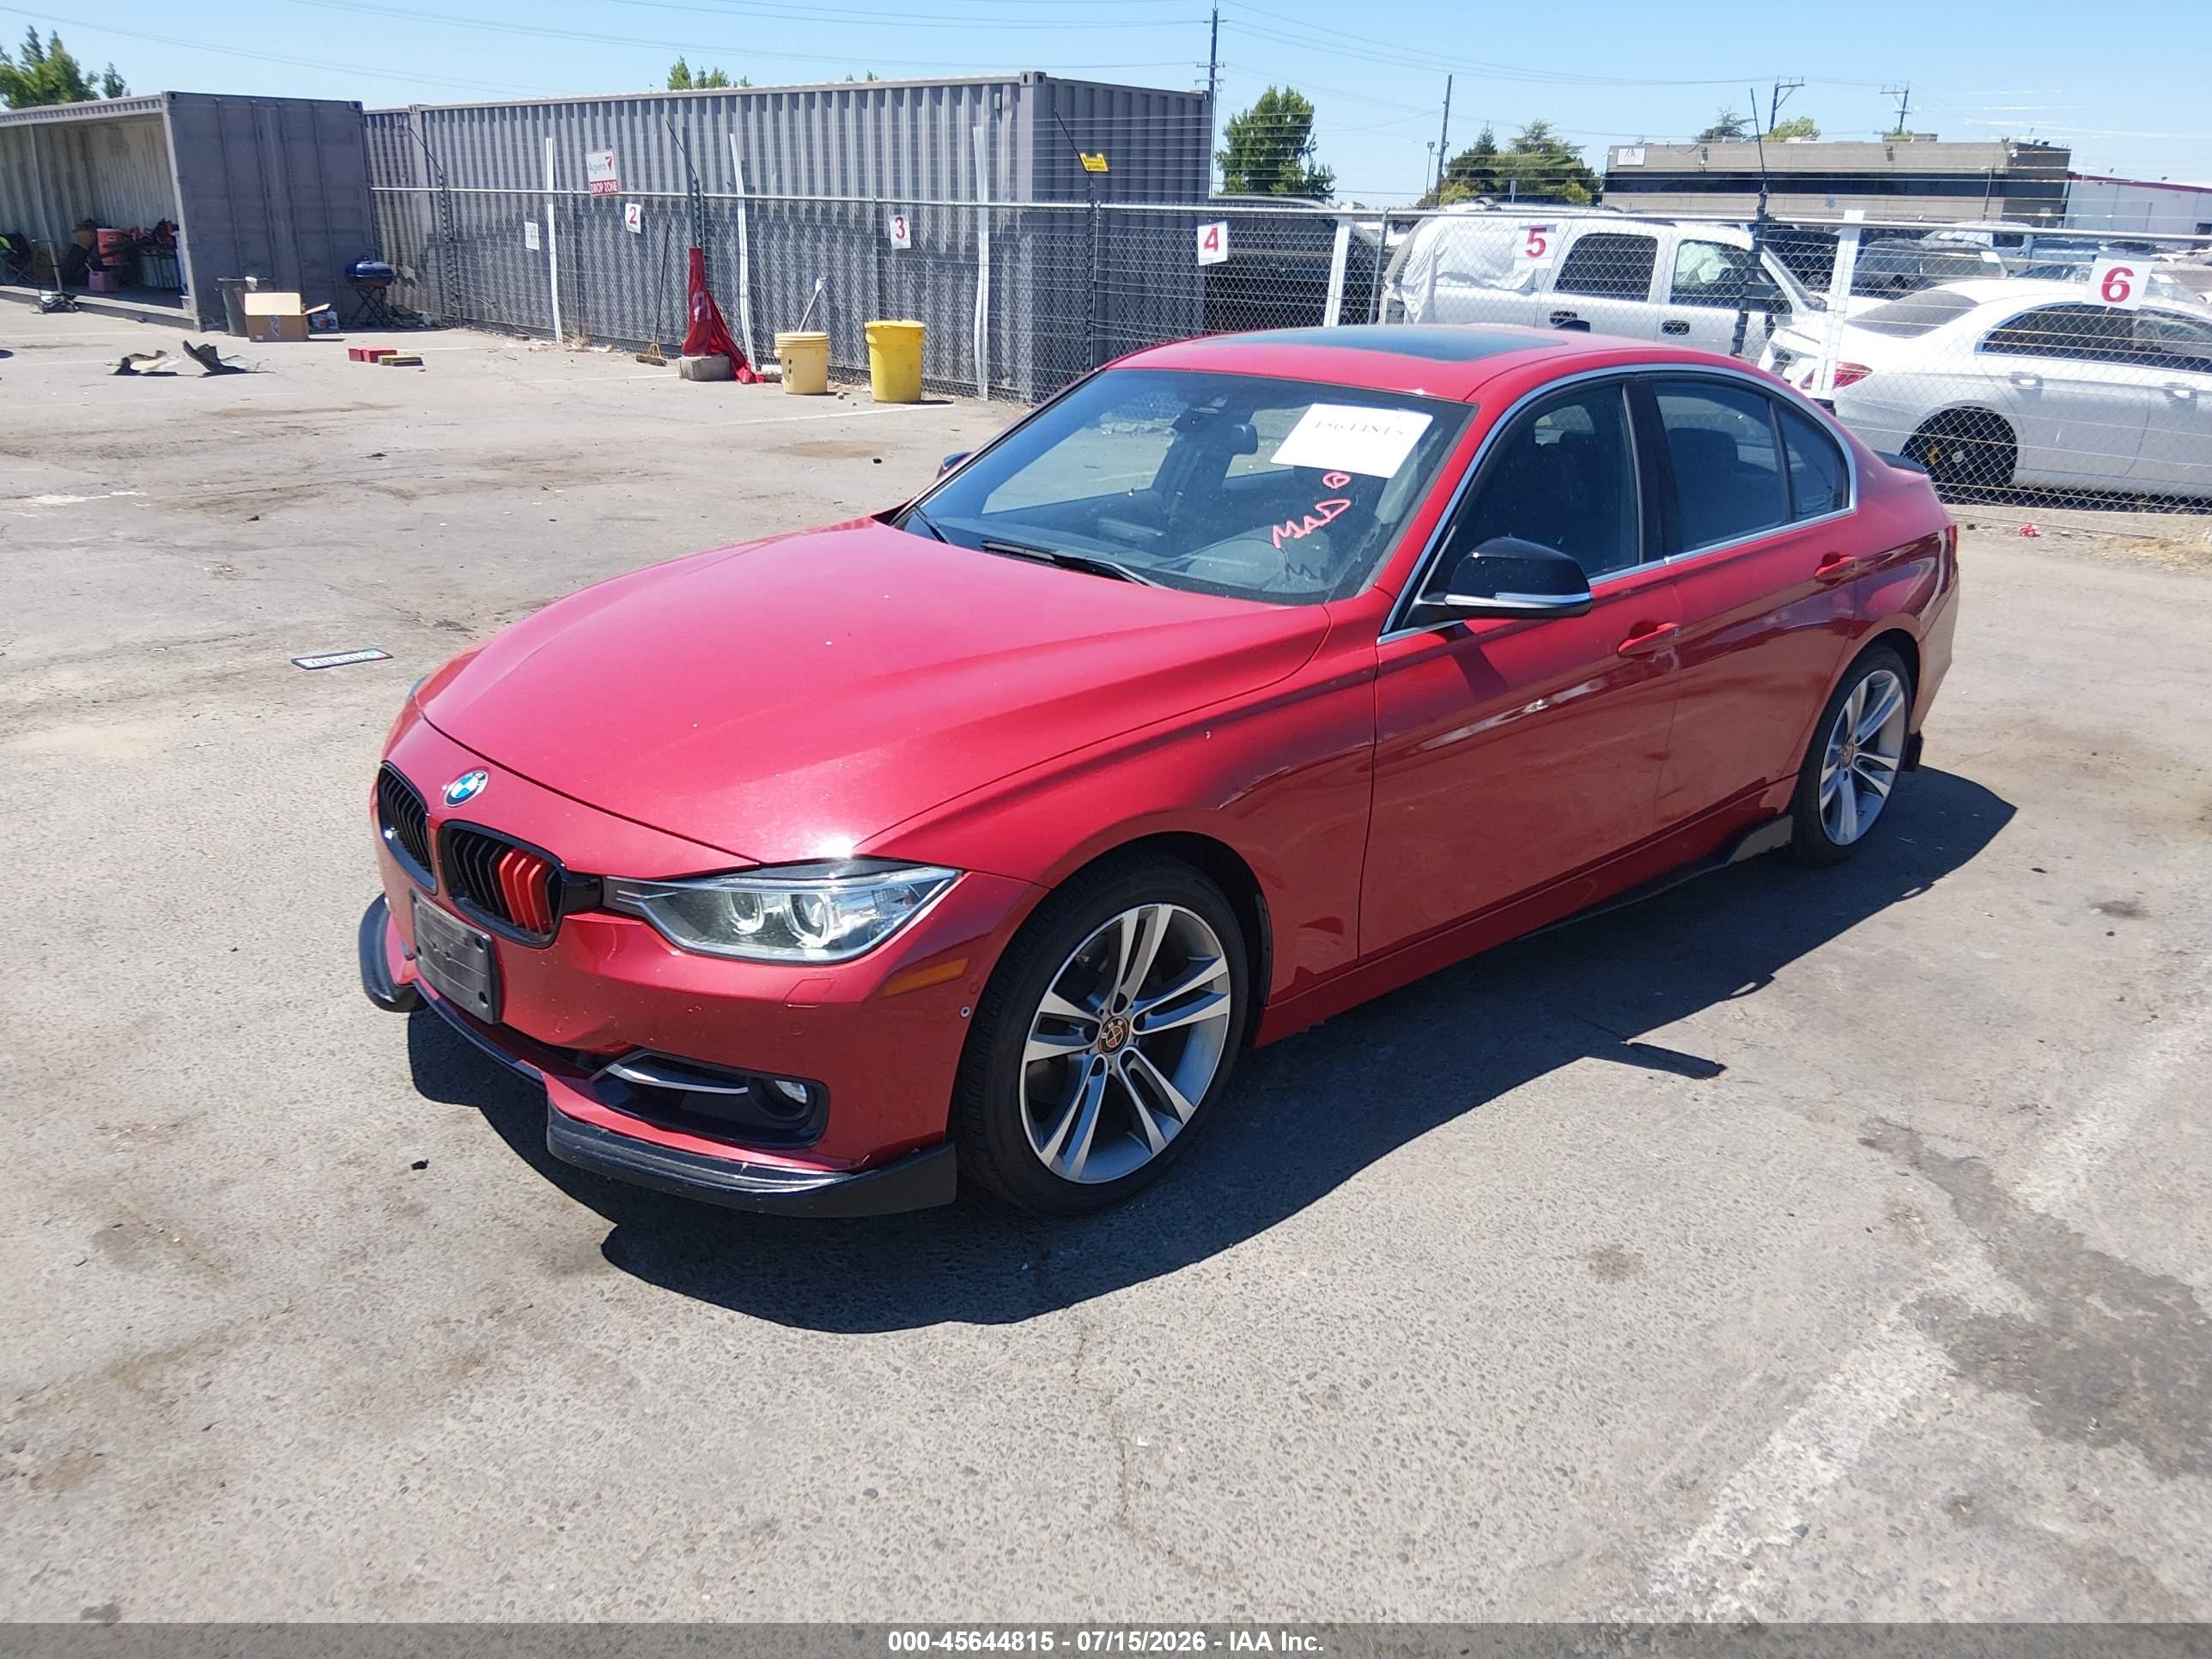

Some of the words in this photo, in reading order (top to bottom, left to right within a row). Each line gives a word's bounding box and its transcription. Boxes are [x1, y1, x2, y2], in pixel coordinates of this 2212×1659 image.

[590, 181, 605, 194] DROP
[603, 179, 618, 193] ZONE
[629, 206, 638, 225] 2
[895, 216, 906, 240] 3
[1203, 227, 1218, 252] 4
[1525, 227, 1547, 258] 5
[2101, 266, 2135, 302] 6
[1272, 499, 1352, 550] MAD
